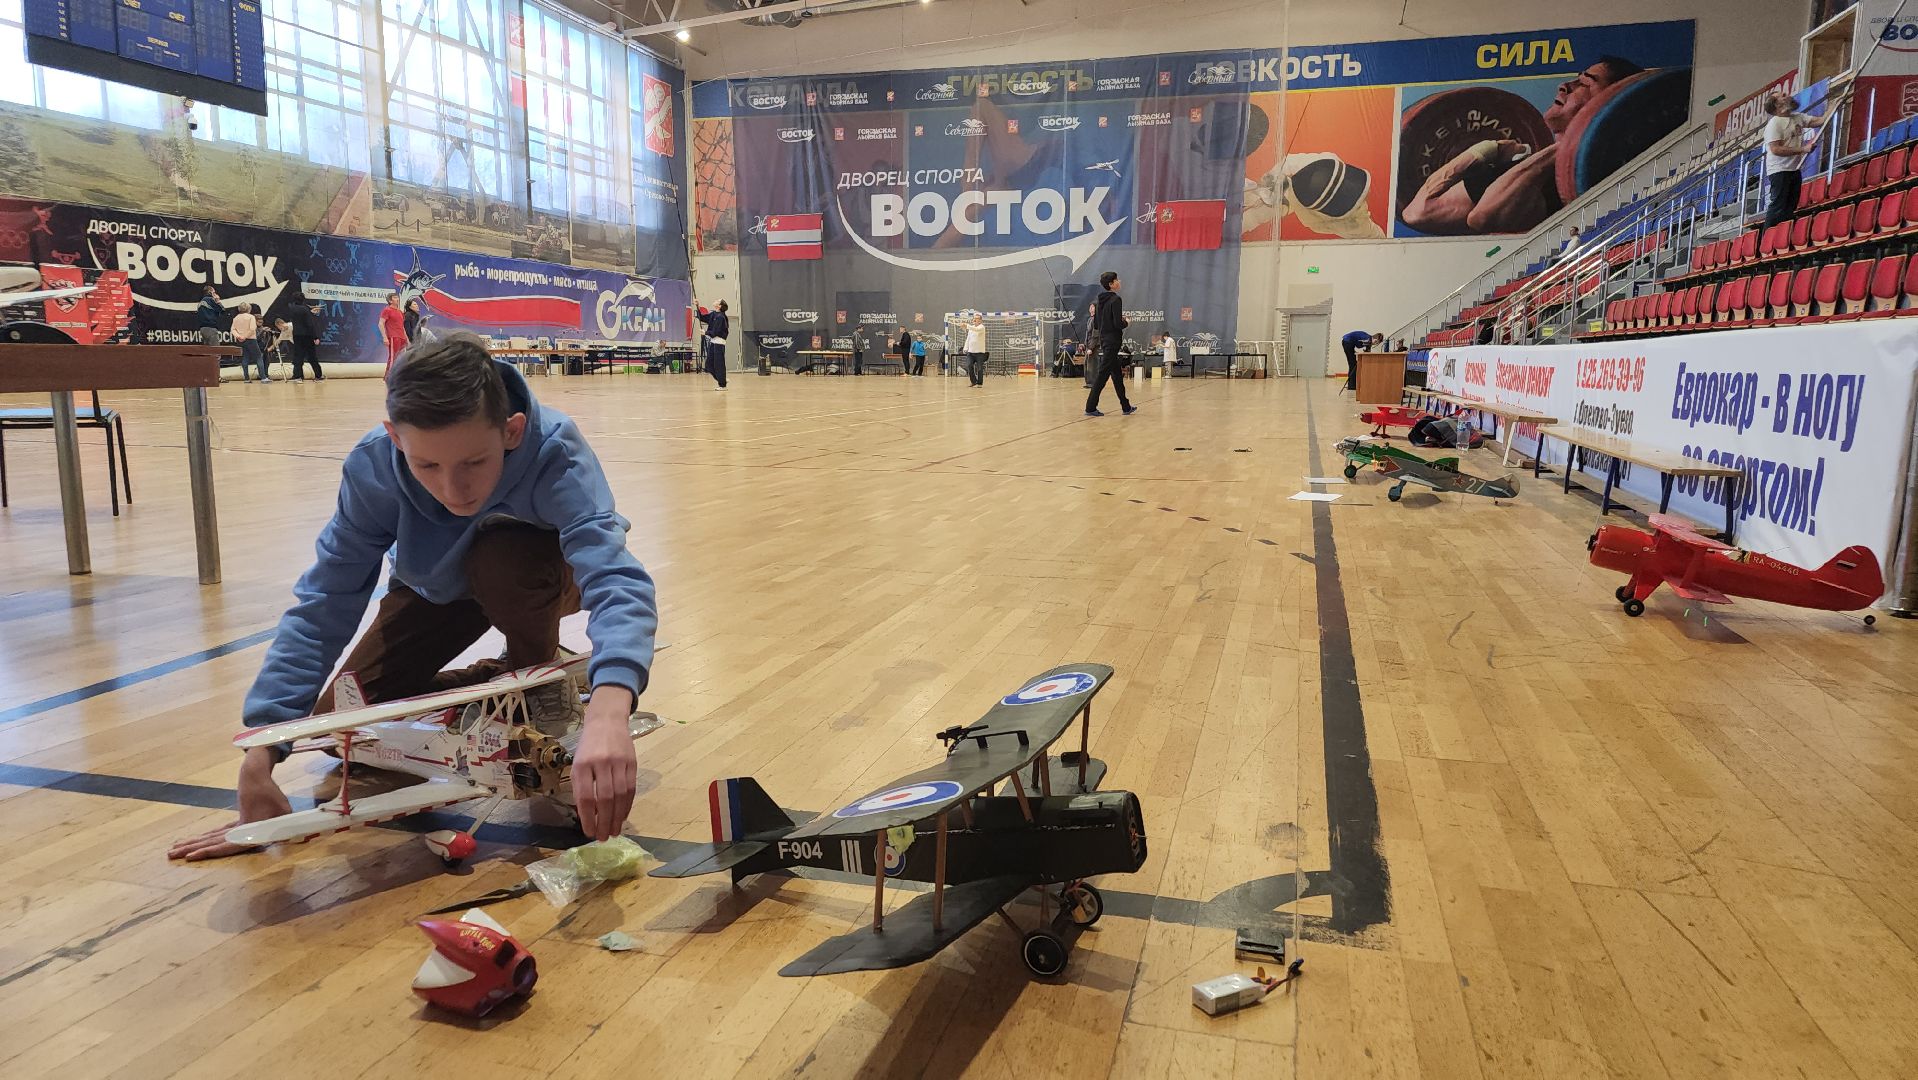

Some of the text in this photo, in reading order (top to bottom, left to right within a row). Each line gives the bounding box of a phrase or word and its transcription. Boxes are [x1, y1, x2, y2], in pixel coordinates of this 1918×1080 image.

[1476, 38, 1574, 69] СИЛА
[1013, 82, 1050, 91] ВОСТОК
[753, 96, 786, 105] ВОСТОК
[1042, 116, 1079, 126] ВОСТОК
[781, 129, 814, 138] ВОСТОК
[836, 168, 984, 190] ДВОРЕЦ СПОРТА
[870, 186, 1111, 237] ВОСТОК
[86, 220, 202, 242] ДВОРЕЦ СПОРТА
[116, 242, 279, 289] ВОСТОК
[455, 262, 597, 292] рыба морепродукты мясо птица
[1672, 362, 1758, 435] Еврокар
[1792, 373, 1866, 452] ногу
[1465, 478, 1486, 493] 27
[1702, 449, 1825, 536] спортом!
[778, 841, 823, 859] F-904
